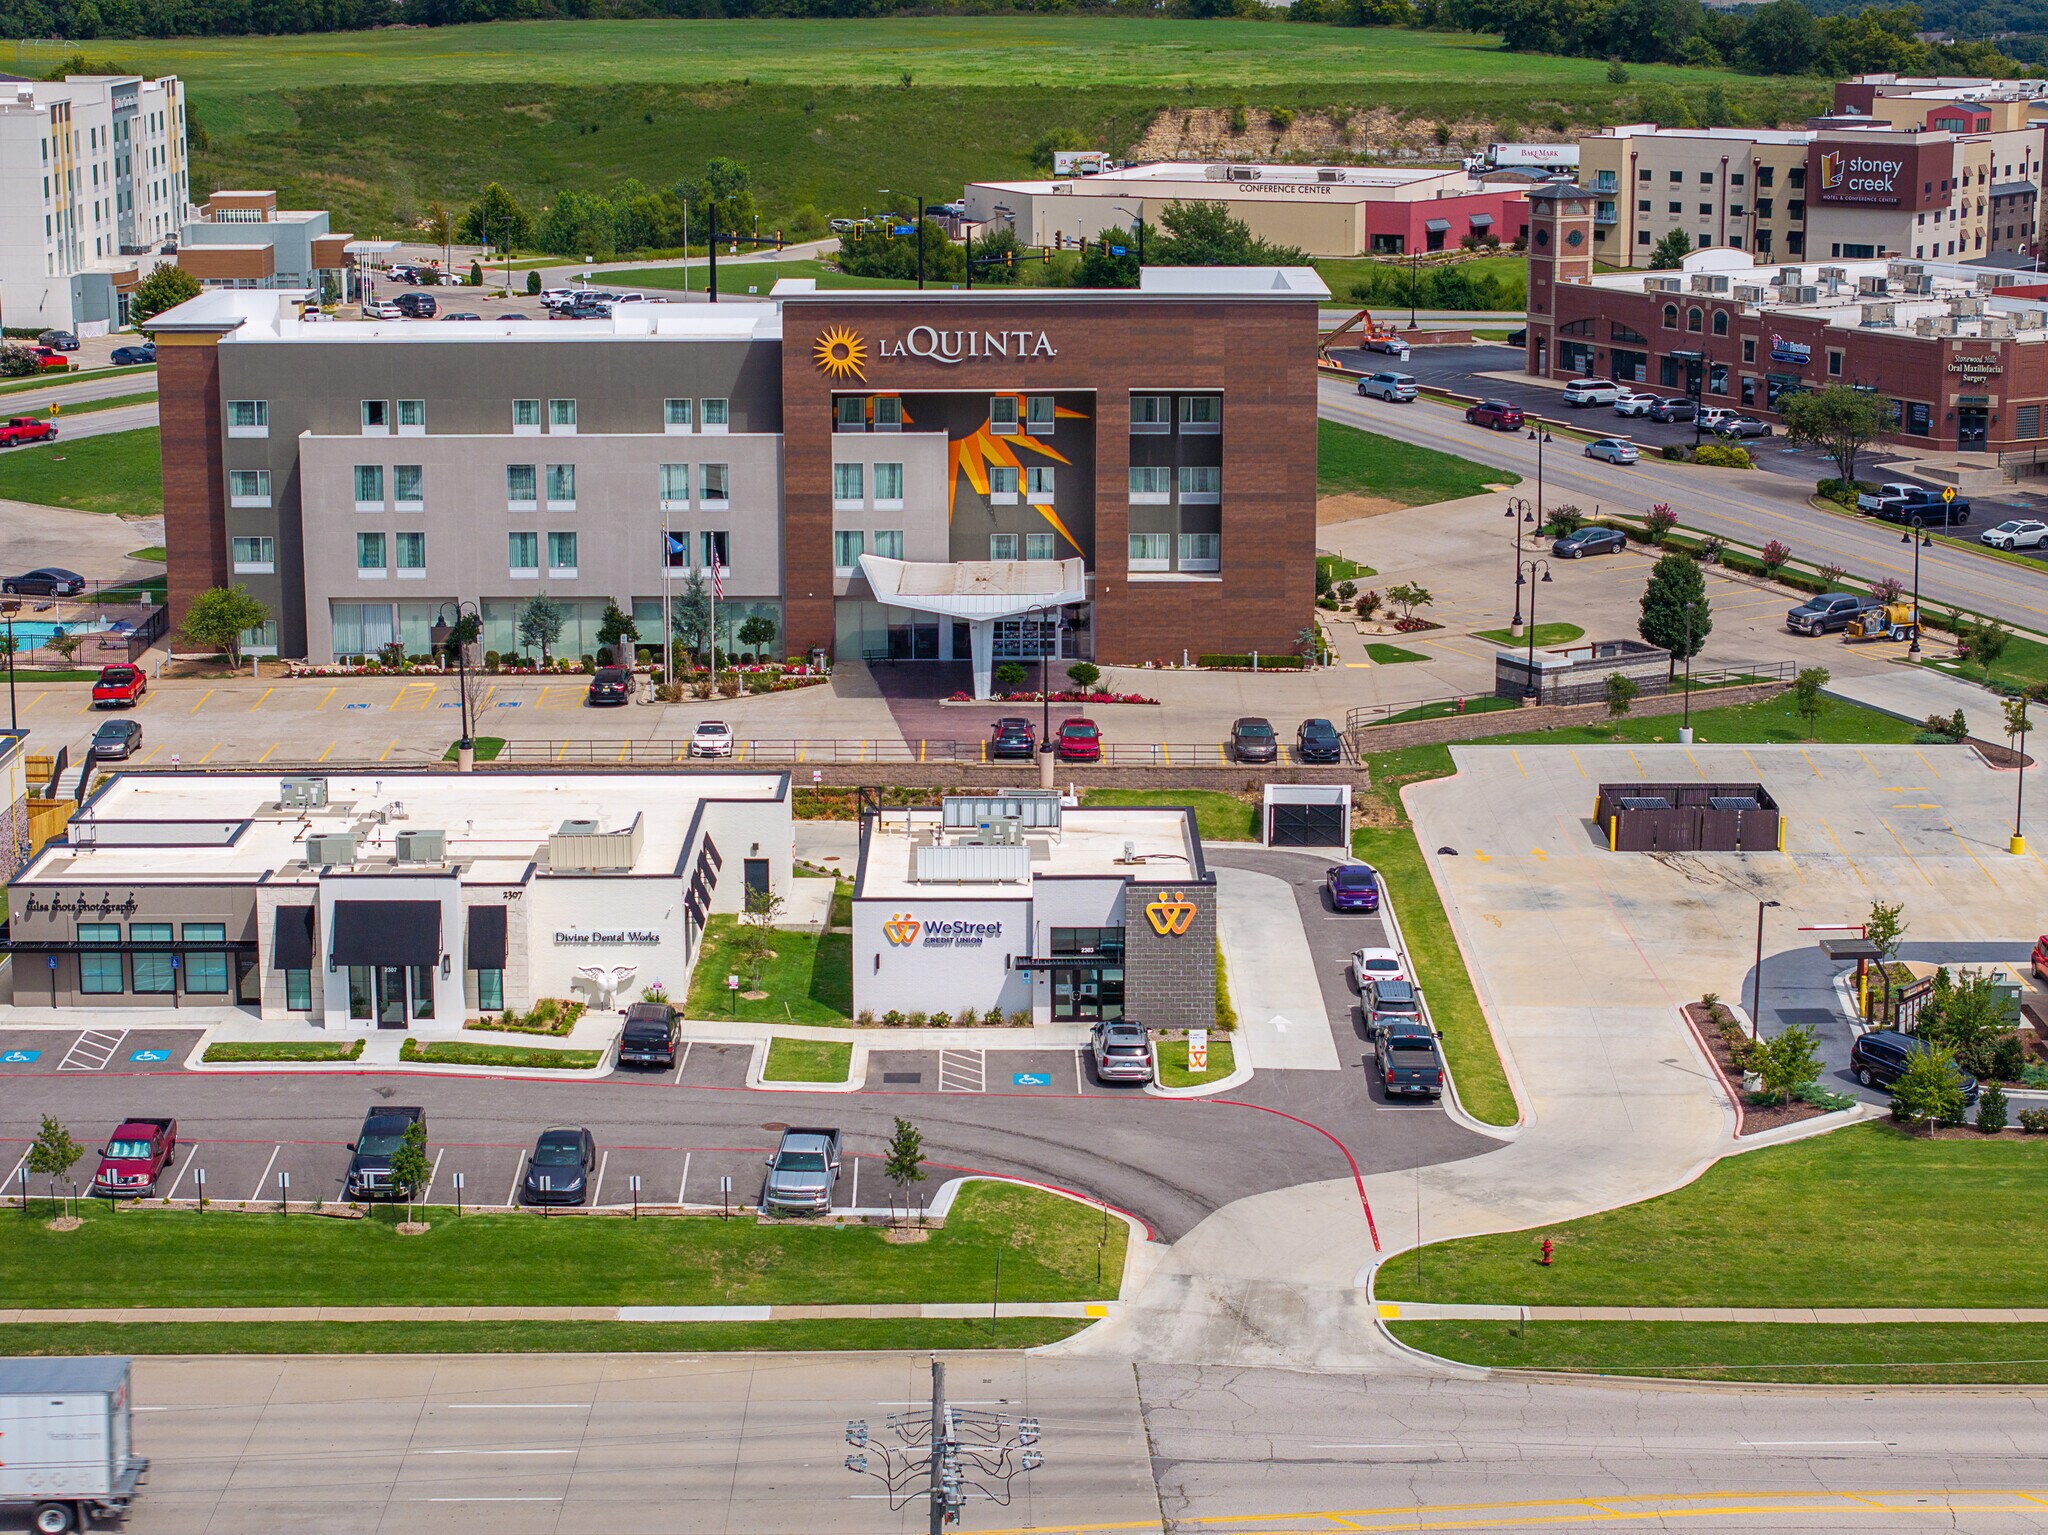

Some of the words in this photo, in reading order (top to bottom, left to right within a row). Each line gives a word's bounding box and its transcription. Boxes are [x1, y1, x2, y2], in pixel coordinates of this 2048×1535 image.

[1849, 156, 1903, 179] stoney
[1239, 183, 1296, 194] CONFERENCE
[1297, 185, 1331, 195] CENTER
[1848, 174, 1894, 192] creek
[1844, 195, 1877, 203] CONFERENCE
[907, 325, 1056, 363] QUINTA
[1954, 354, 1983, 363] Stonewood
[1947, 363, 1963, 372] Oral
[1963, 364, 2004, 374] Maxillofacial
[1962, 374, 1987, 384] Surgery
[502, 890, 523, 901] 2307
[26, 900, 49, 912] tulsa
[78, 900, 139, 915] photography
[924, 920, 1003, 934] WeStreet
[555, 932, 590, 943] Divine
[592, 931, 625, 943] Dental
[628, 931, 661, 943] Works
